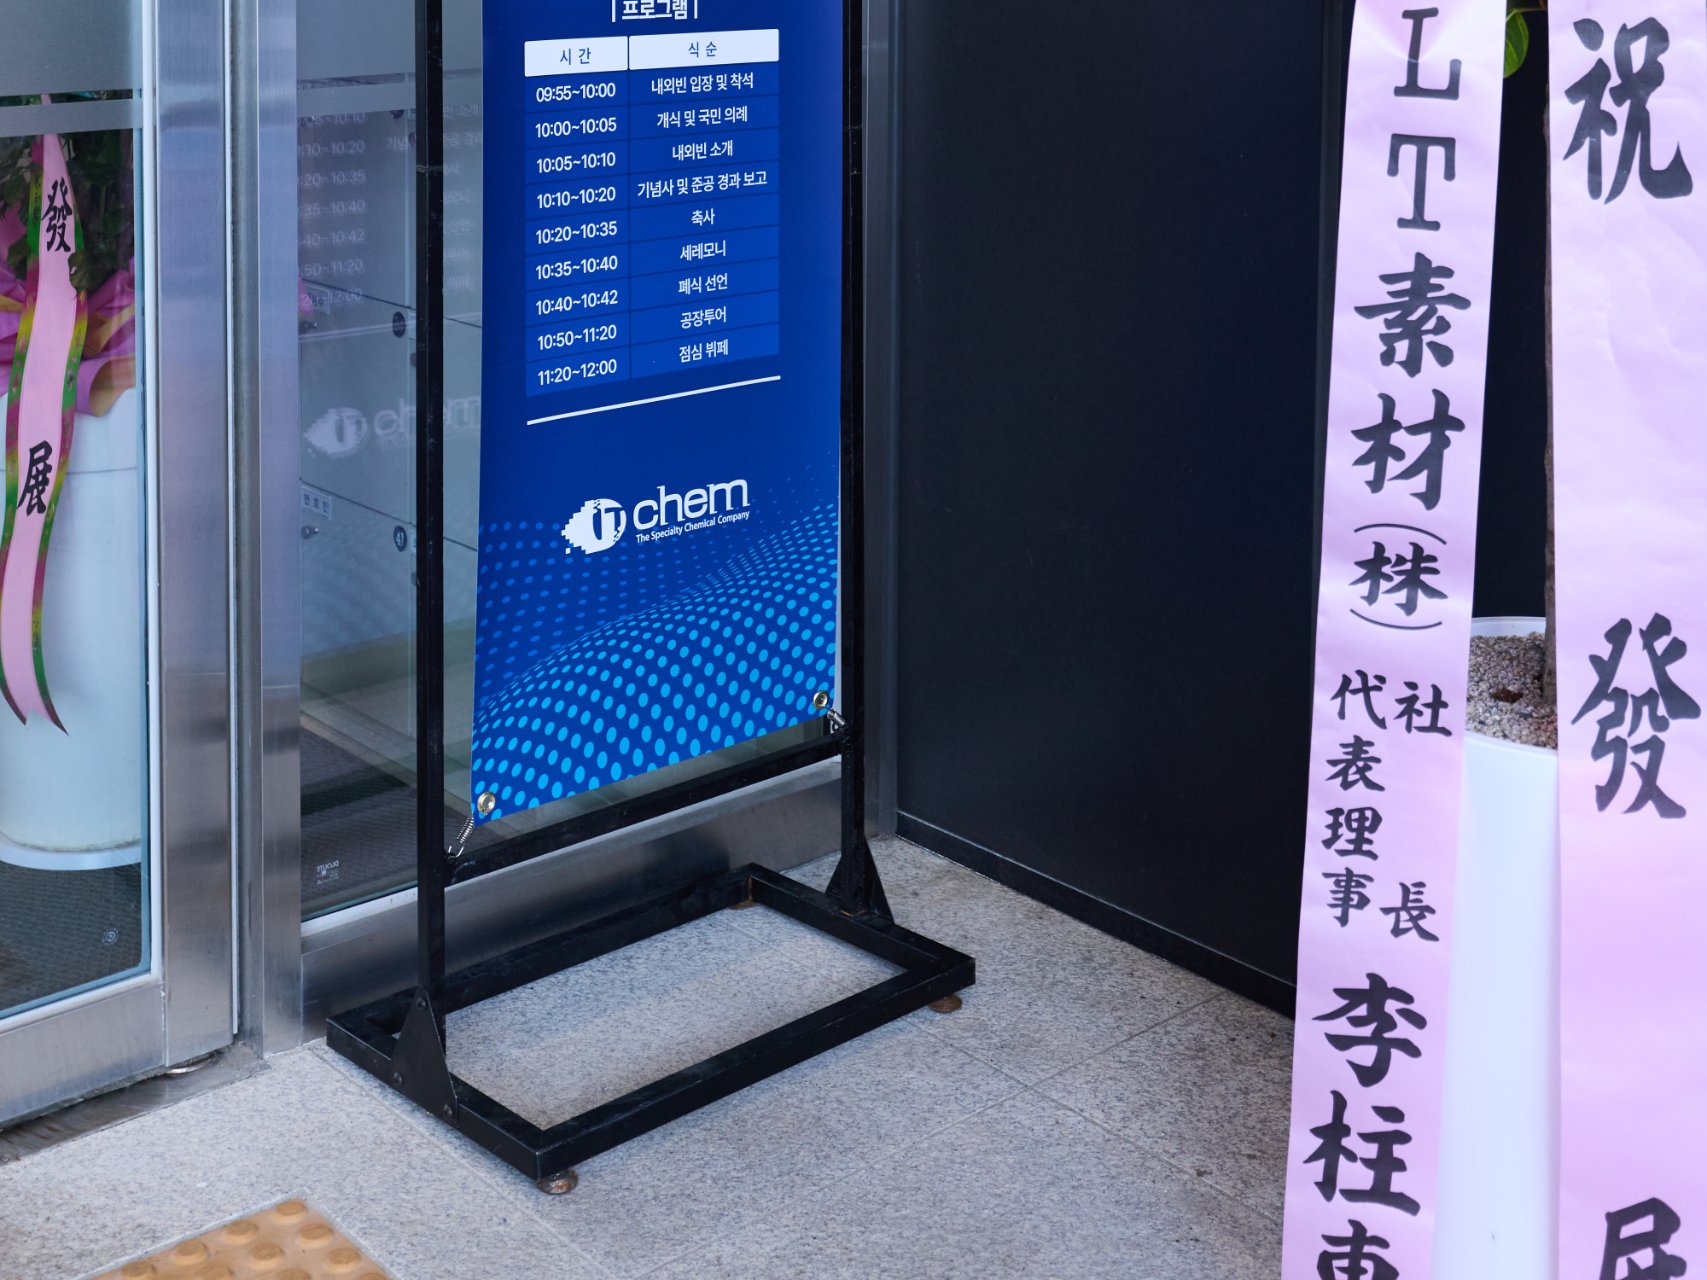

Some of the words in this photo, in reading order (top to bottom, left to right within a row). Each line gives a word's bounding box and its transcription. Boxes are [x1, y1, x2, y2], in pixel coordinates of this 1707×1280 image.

[560, 48, 571, 65] 시
[579, 48, 591, 64] 간
[689, 42, 698, 57] 식
[706, 42, 716, 57] 순
[536, 83, 615, 102] 09:55~10:00
[652, 77, 686, 95] 내외빈
[690, 75, 713, 92] 입장
[717, 74, 727, 90] 및
[731, 72, 753, 89] 착석
[657, 111, 680, 128] 개식
[684, 110, 695, 126] 및
[698, 108, 721, 125] 국민
[725, 106, 747, 122] 의례
[1563, 17, 1694, 205] 祝
[536, 118, 616, 137] 10:00~10:05
[673, 143, 706, 160] 내외빈
[710, 140, 732, 156] 소개
[537, 152, 615, 173] 10:05~10:10
[638, 179, 674, 198] 기념사
[677, 178, 688, 194] 및
[691, 176, 714, 193] 준공
[718, 173, 741, 190] 경과
[743, 171, 767, 186] 보고
[537, 187, 615, 208] 10:10~10:20
[42, 177, 74, 253] 發
[691, 208, 715, 225] 축사
[536, 221, 617, 244] 10:20~10:35
[680, 240, 725, 260] 세레모니
[536, 256, 617, 279] 10:35~10:40
[705, 273, 727, 291] 선언
[536, 290, 618, 315] 10:40~10:42
[681, 306, 726, 328] 공장투어
[538, 325, 616, 350] 10:50~11:20
[680, 344, 702, 362] 점심
[706, 339, 728, 357] 뷔페
[538, 359, 617, 385] 11:20~12:00
[17, 440, 53, 515] 展
[632, 478, 751, 530] chem
[636, 533, 650, 544] The
[651, 526, 683, 542] Specialty
[684, 517, 716, 533] Chemical
[717, 510, 750, 525] Company
[1321, 669, 1388, 928] 代表理事
